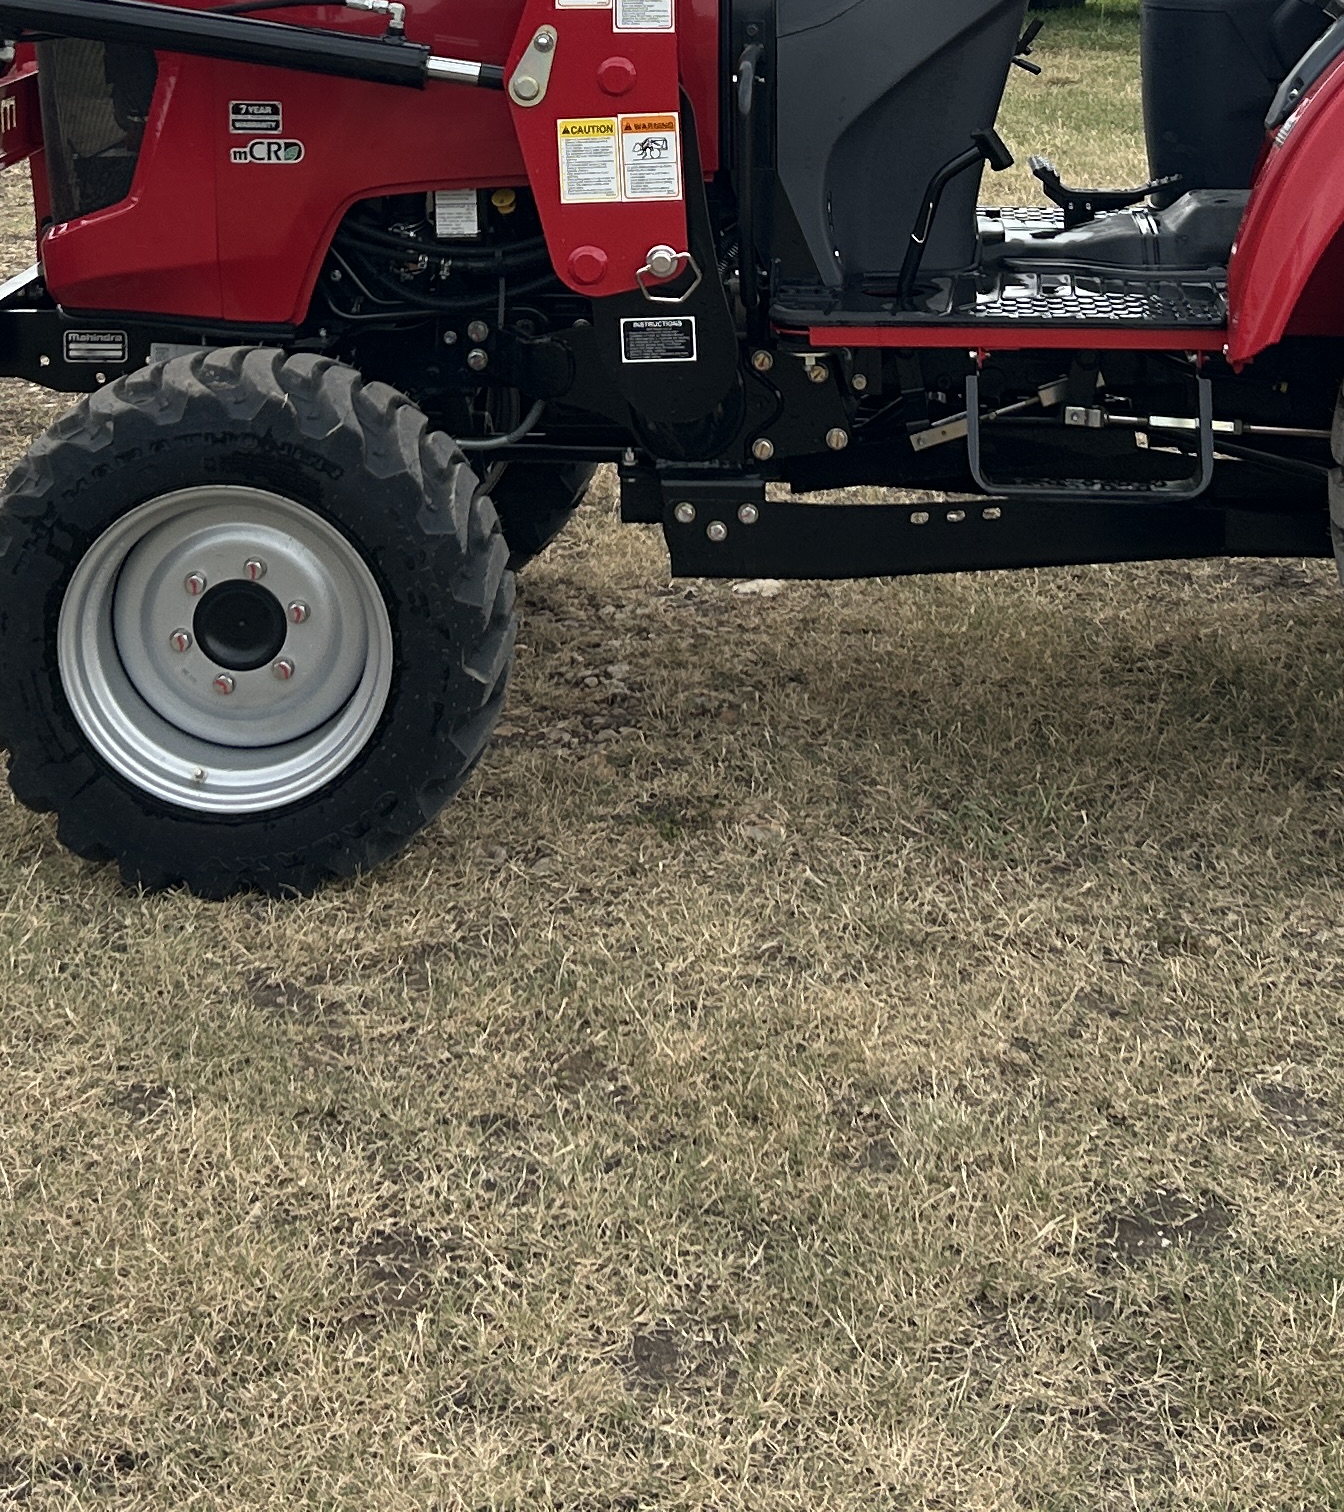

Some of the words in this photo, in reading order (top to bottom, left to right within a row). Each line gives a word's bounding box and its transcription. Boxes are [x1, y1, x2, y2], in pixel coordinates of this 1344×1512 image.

[239, 104, 248, 114] 7
[247, 105, 272, 114] YEAR
[570, 124, 614, 135] CAUTION
[633, 122, 674, 130] WARNING
[632, 320, 683, 328] INSTRUCTIONS
[68, 333, 123, 342] Mahindra
